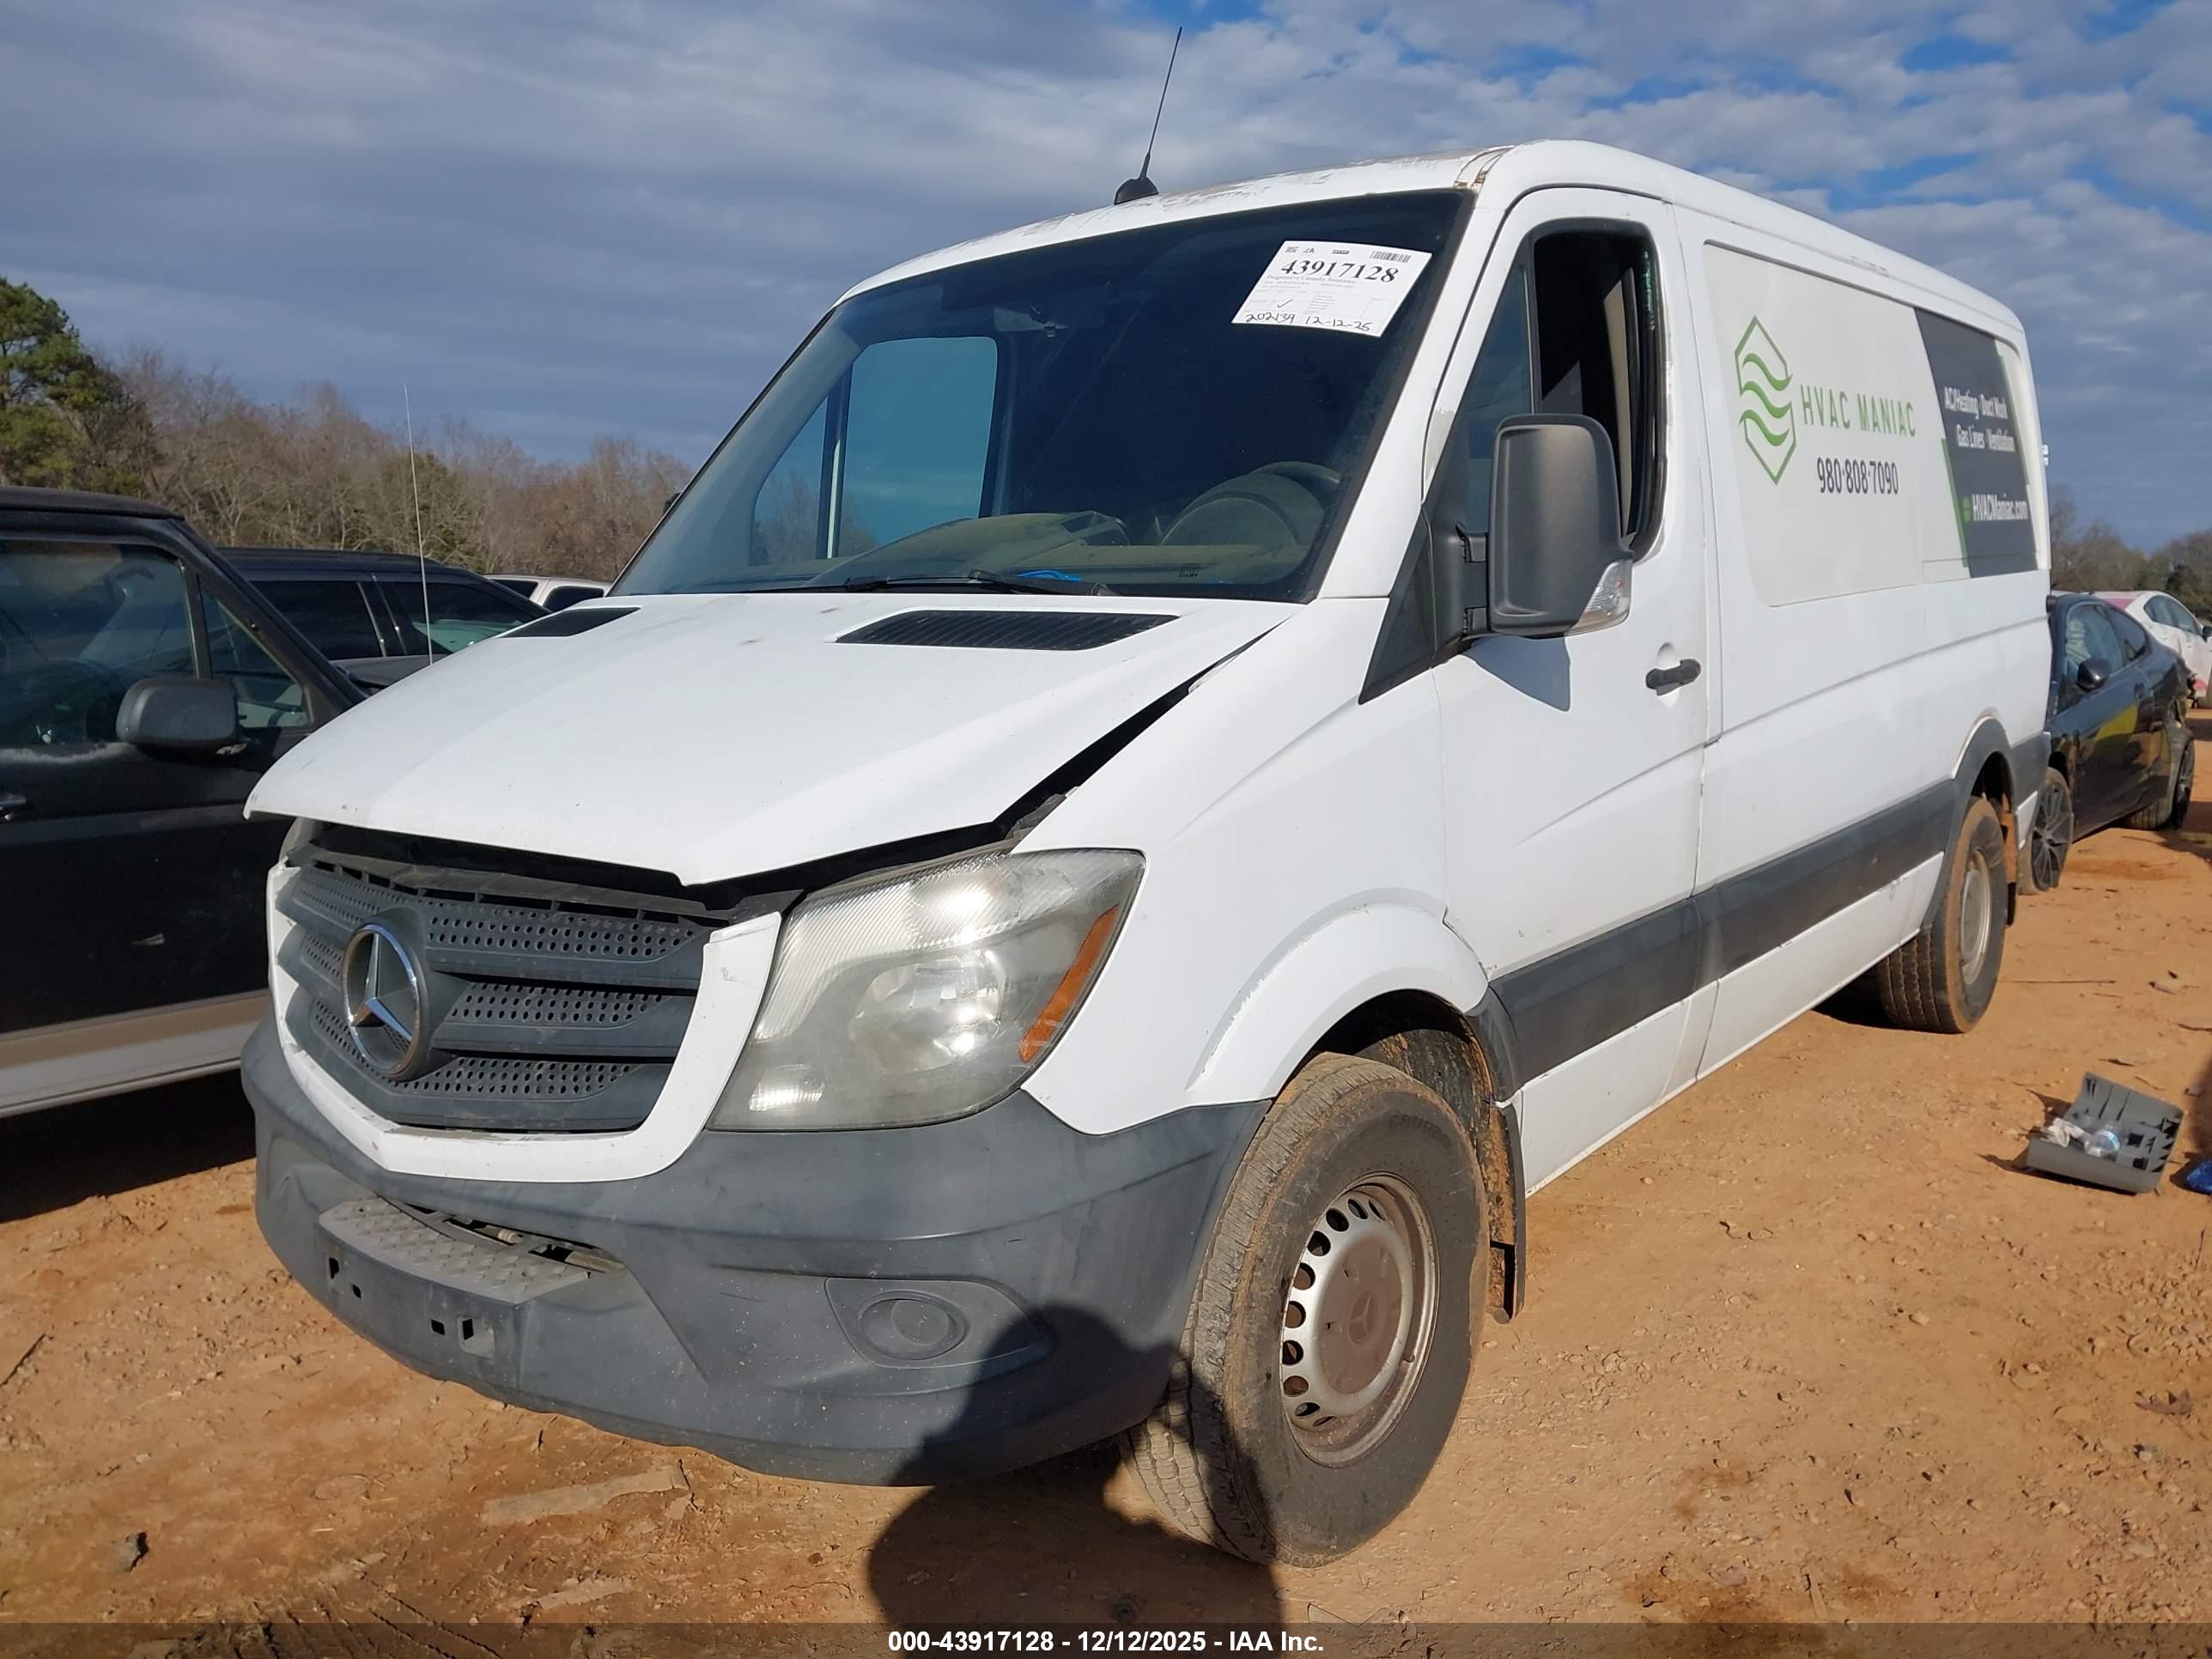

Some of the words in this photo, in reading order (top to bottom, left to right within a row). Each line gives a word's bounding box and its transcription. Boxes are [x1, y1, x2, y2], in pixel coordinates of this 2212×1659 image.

[1281, 259, 1399, 283] 43917128
[1305, 315, 1373, 331] 12-12-25
[1800, 384, 1850, 428] HVAC
[1856, 393, 1917, 438] MANIAC
[1956, 424, 1969, 447] Gas
[1970, 424, 1985, 448] Lines
